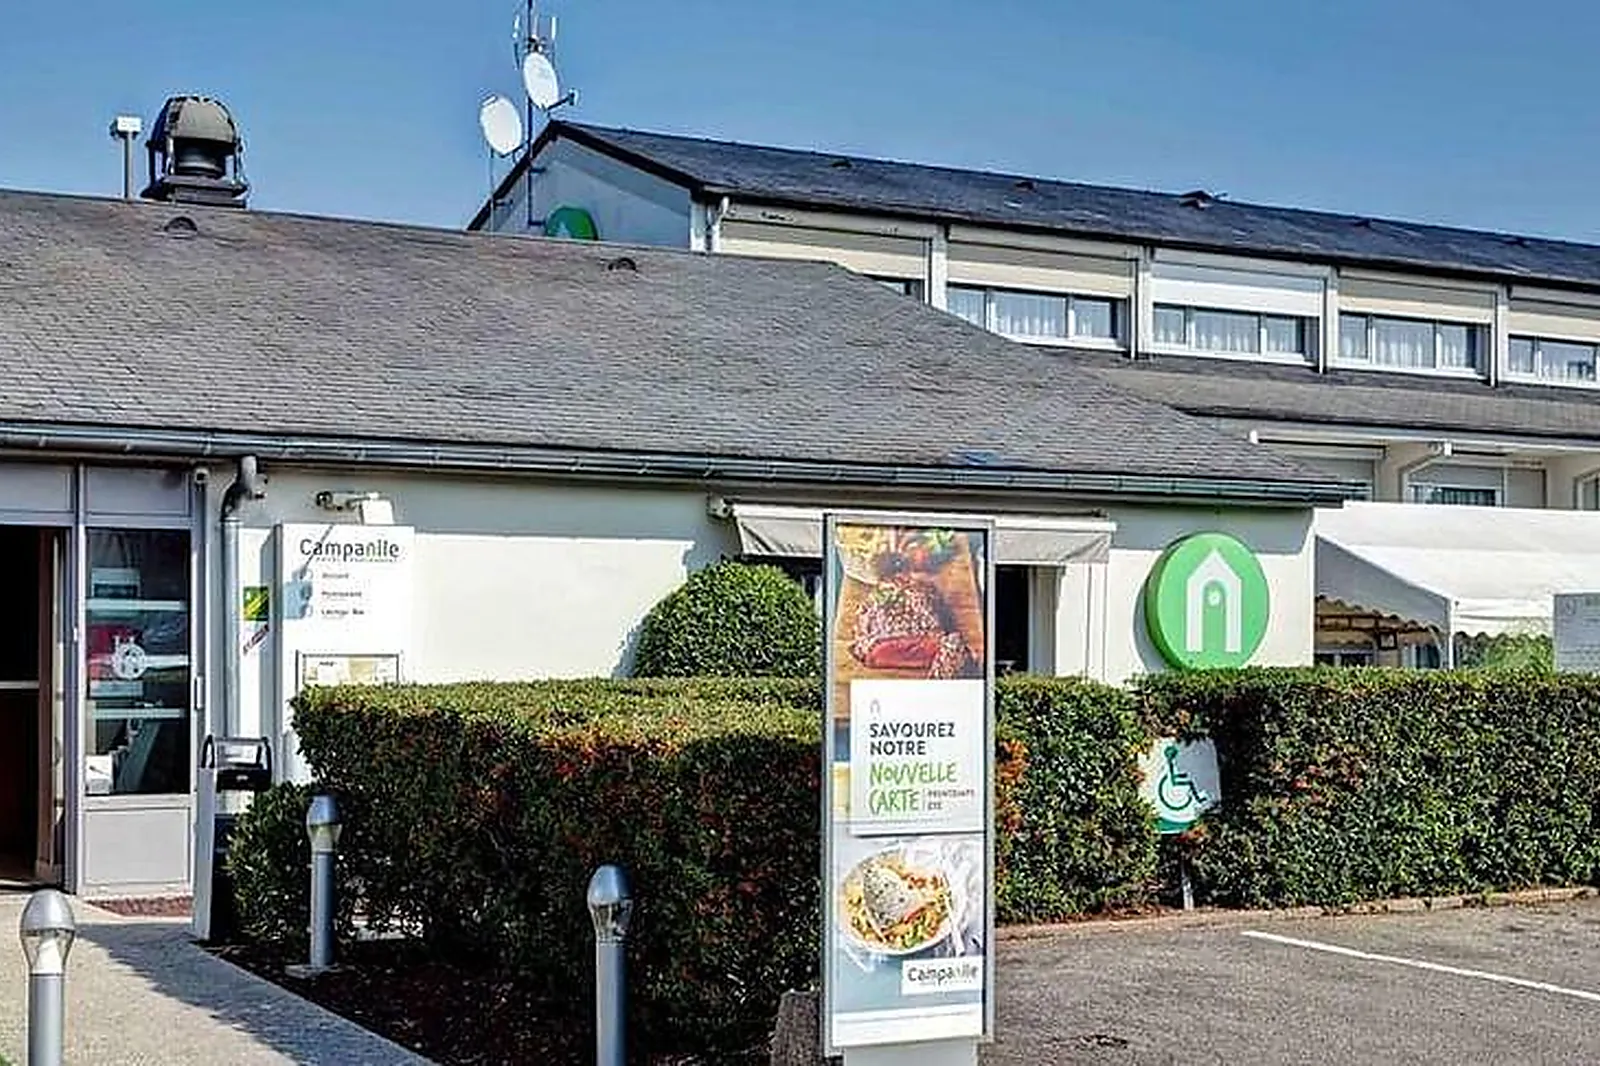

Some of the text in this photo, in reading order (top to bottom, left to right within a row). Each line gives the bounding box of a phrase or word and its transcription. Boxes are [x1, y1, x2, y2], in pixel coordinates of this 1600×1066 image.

[300, 538, 399, 562] Campanile
[870, 722, 955, 738] SAVOUREZ
[870, 740, 926, 755] NOTRE
[869, 761, 957, 786] NOUVELLE
[868, 788, 920, 814] CARTE
